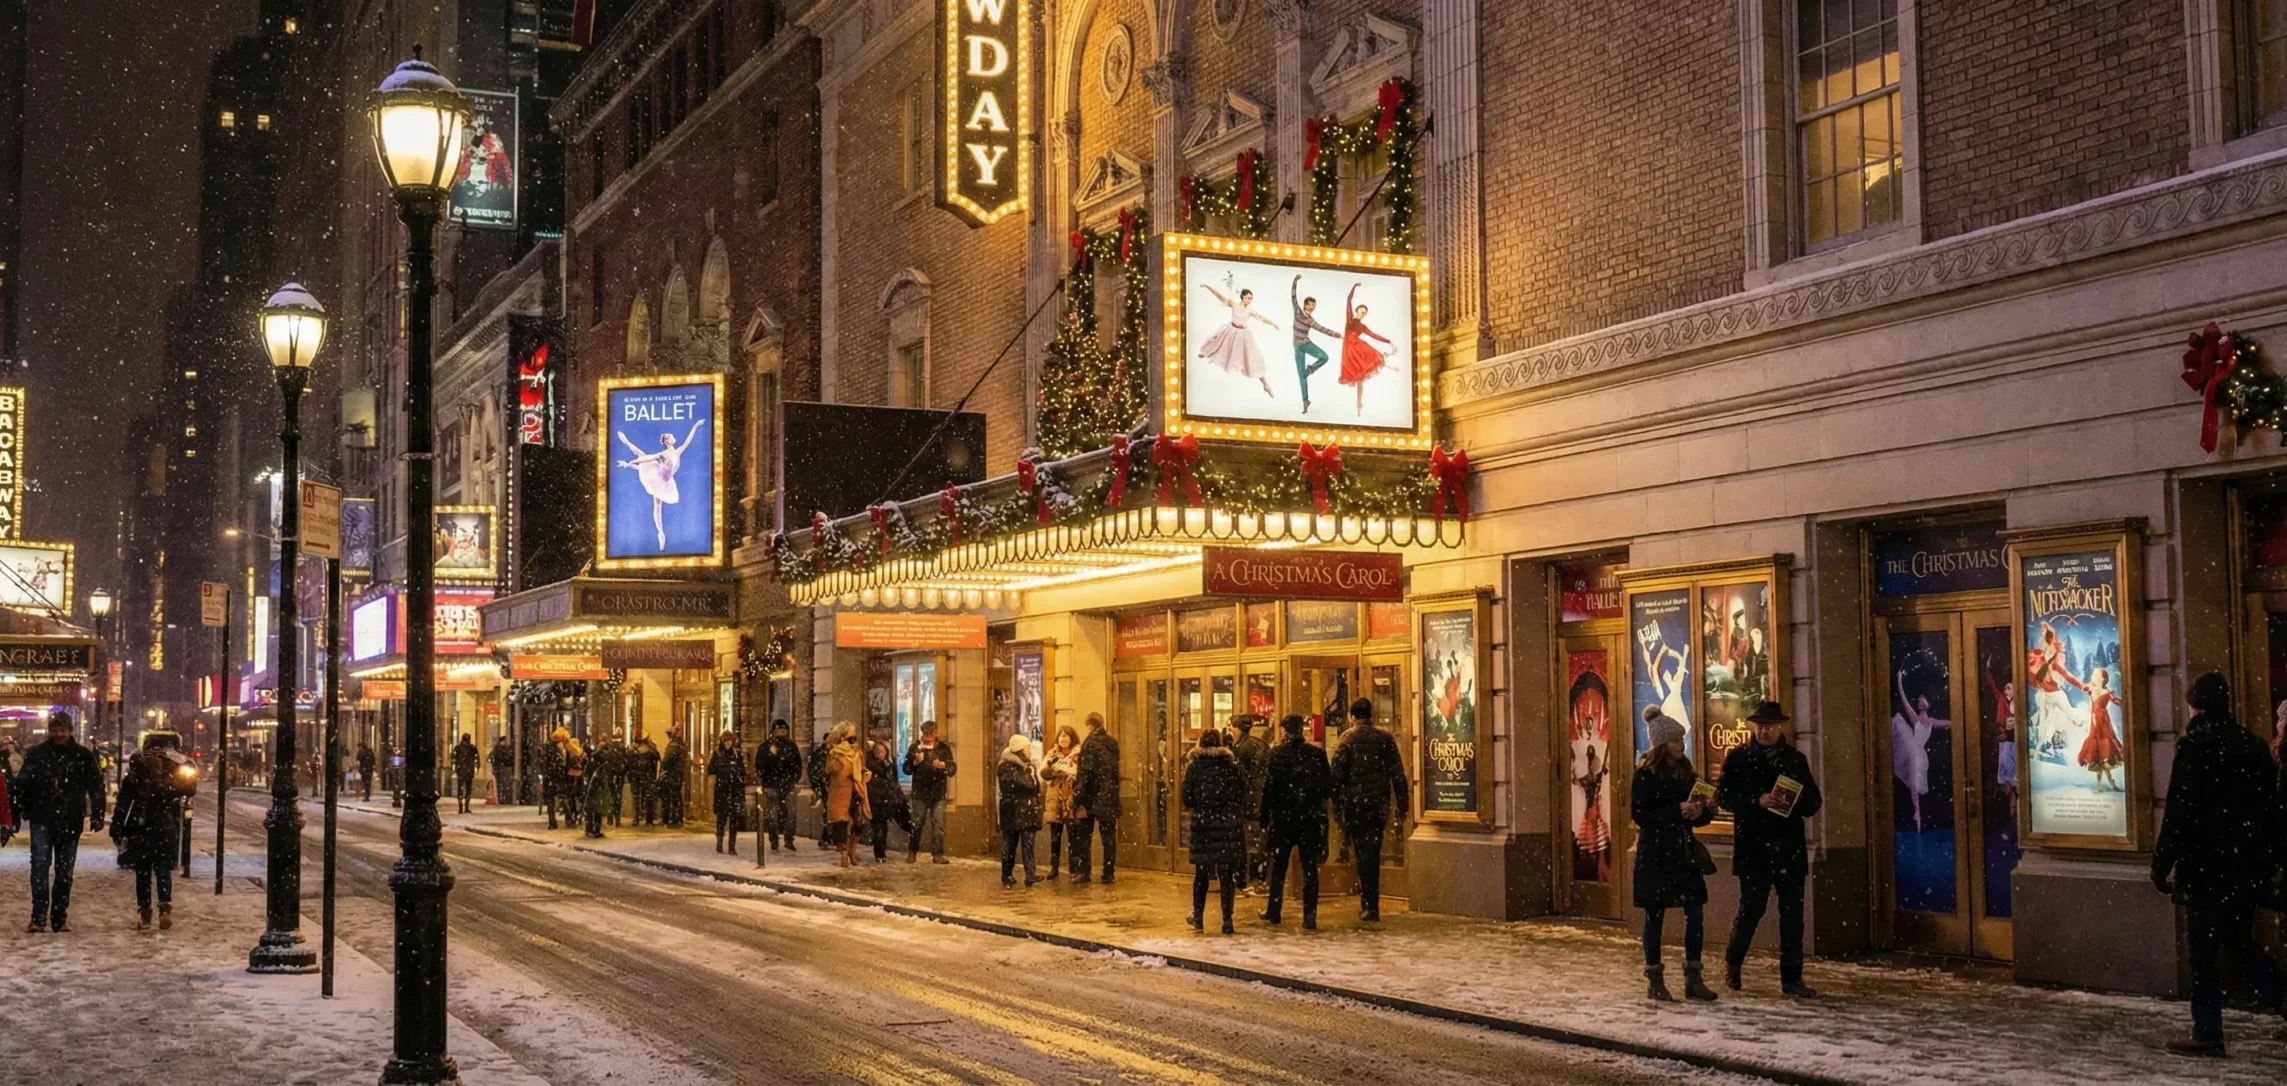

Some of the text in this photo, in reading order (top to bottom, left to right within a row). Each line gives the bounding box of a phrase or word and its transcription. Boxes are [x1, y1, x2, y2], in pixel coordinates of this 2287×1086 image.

[624, 402, 696, 422] BALLET
[1213, 558, 1393, 590] A CHRISTMAS CAROL
[1886, 560, 1909, 574] THE
[1912, 549, 1999, 578] CHRISTMAS
